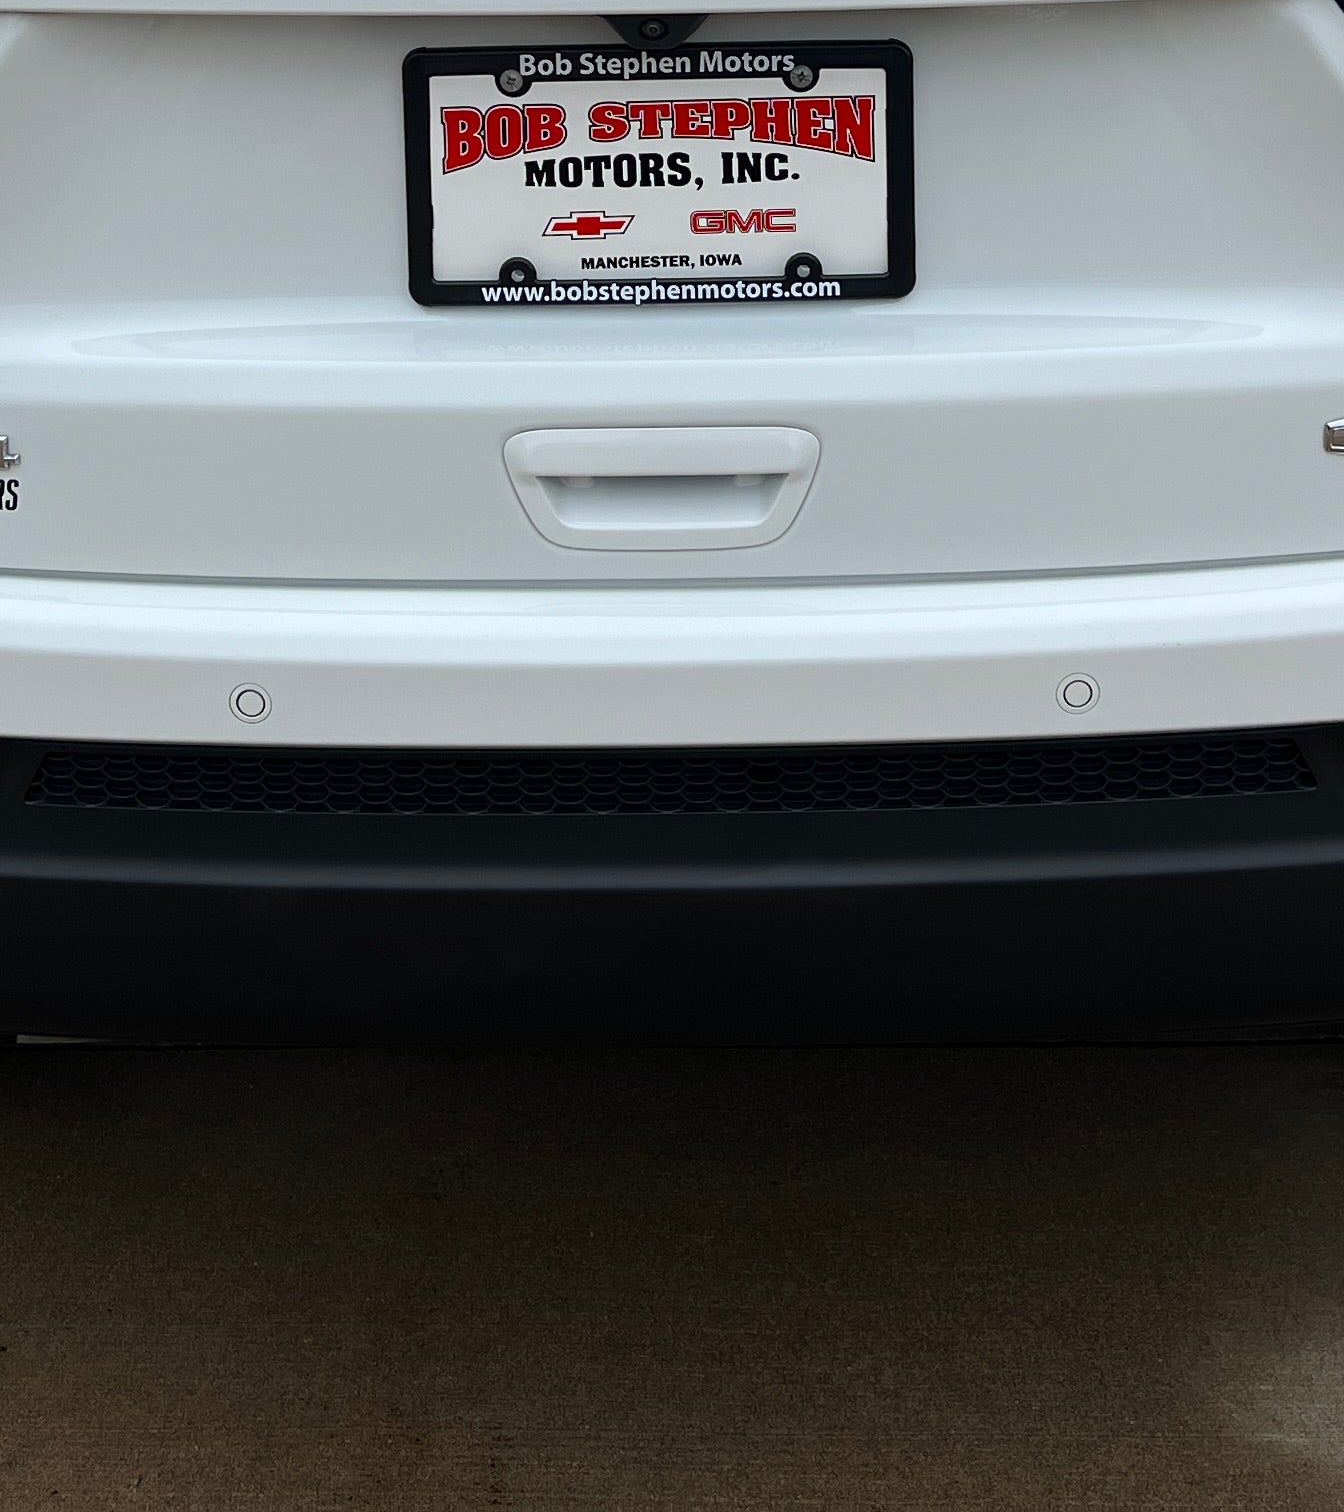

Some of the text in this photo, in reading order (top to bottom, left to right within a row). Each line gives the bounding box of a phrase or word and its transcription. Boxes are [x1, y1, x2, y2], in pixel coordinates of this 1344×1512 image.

[519, 51, 795, 81] Bob Stephen Motors
[440, 95, 876, 175] BOB STEPHEN
[524, 152, 800, 190] MOTORS, INC.
[690, 208, 796, 234] GMC
[581, 254, 743, 270] MANCHESTER, IOWA
[481, 280, 841, 304] www.bobstephenmotors.com
